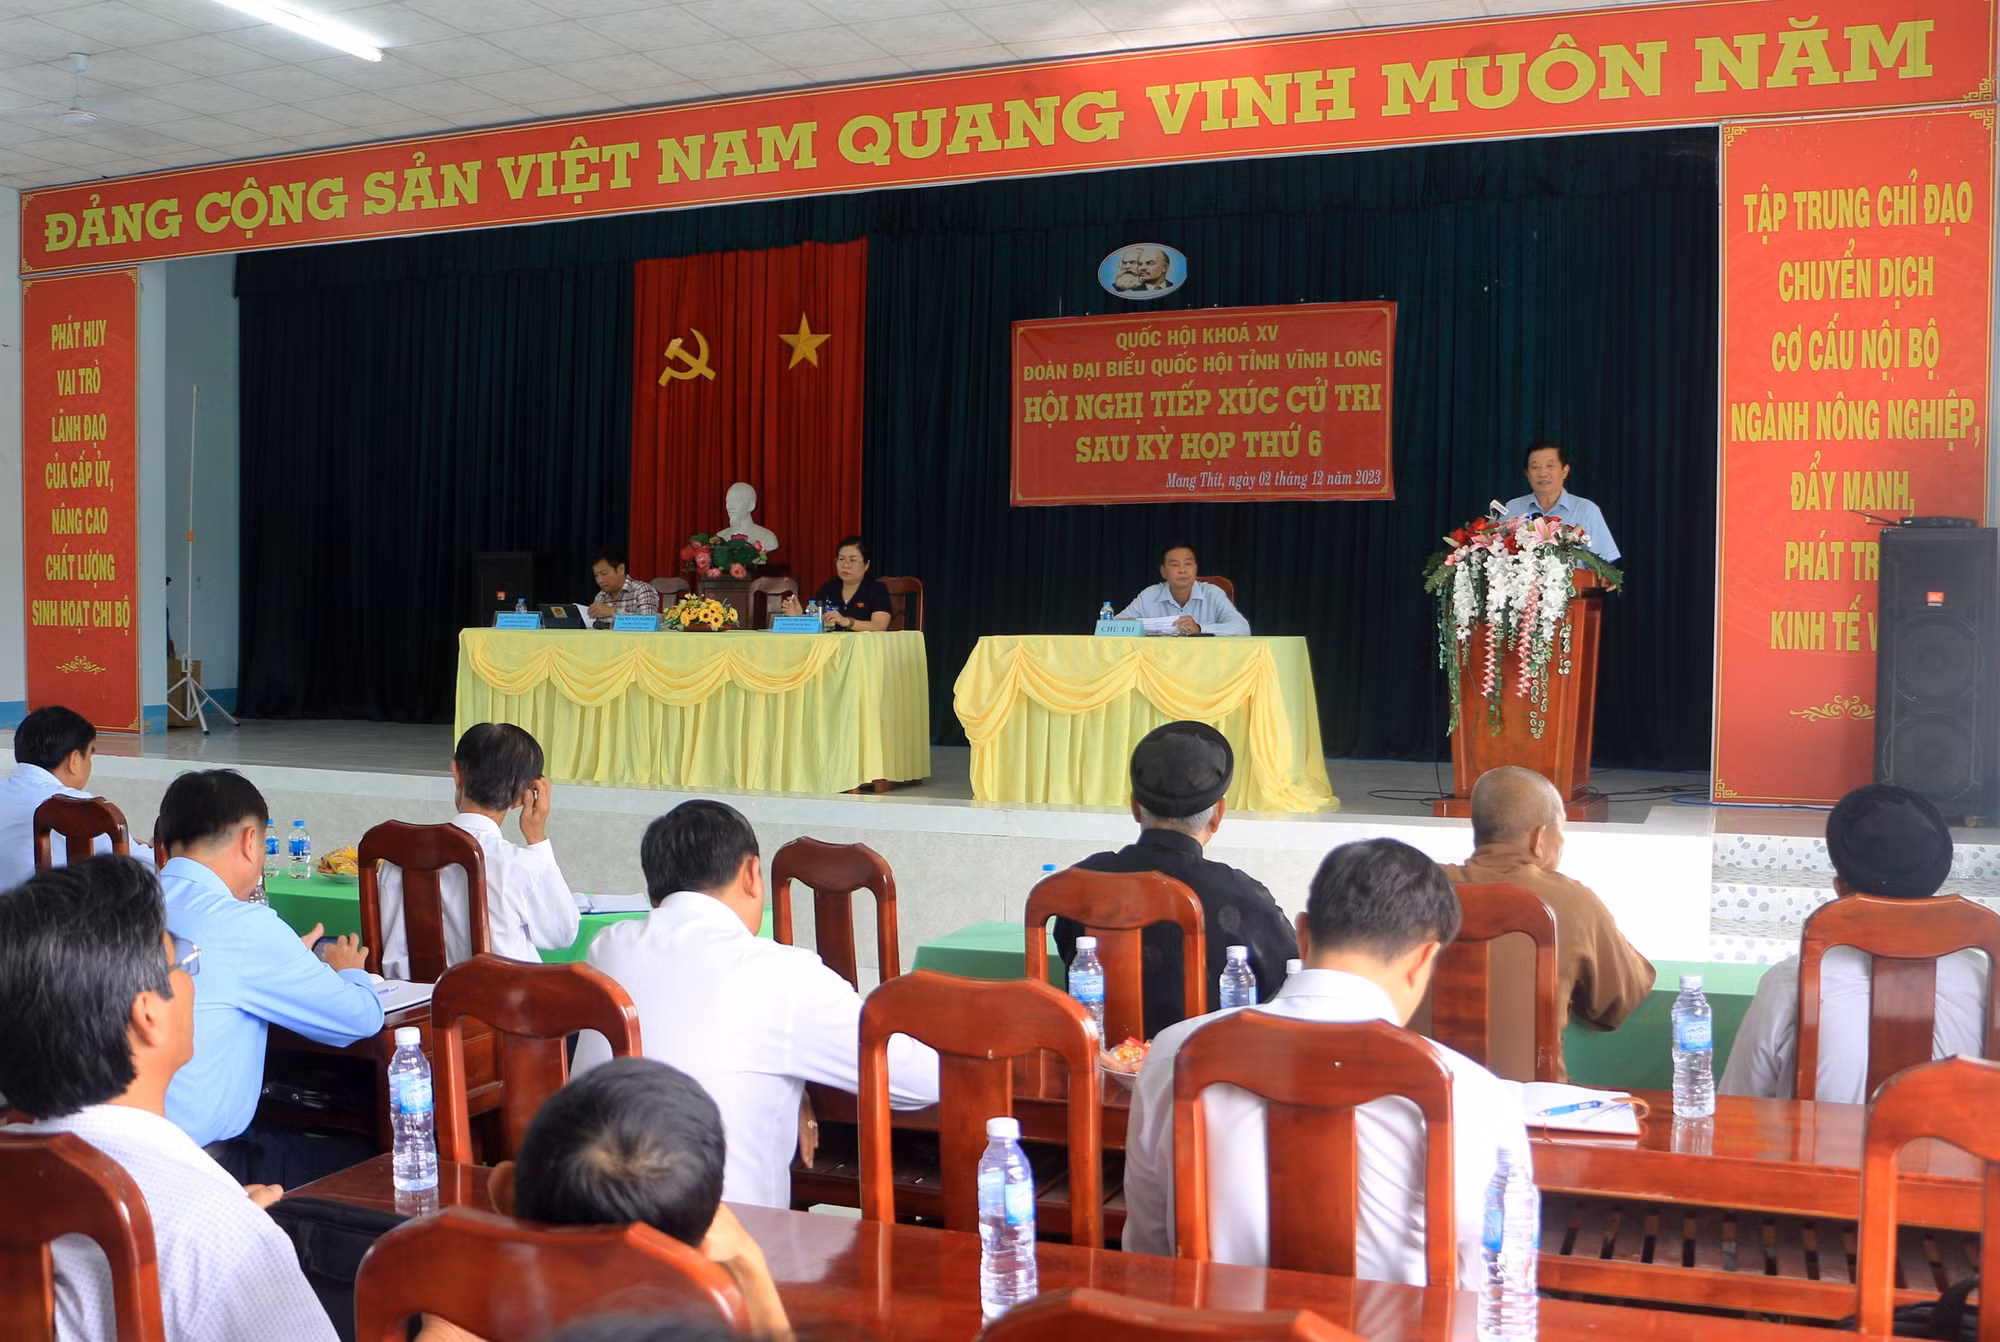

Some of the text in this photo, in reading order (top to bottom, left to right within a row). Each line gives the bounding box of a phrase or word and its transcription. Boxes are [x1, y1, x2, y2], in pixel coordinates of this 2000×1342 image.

[44, 15, 1935, 253] ĐẢNG CỘNG SẢN VIỆT NAM QUANG VINH MUÔN NĂM
[1743, 168, 1973, 245] TẬP TRUNG CHỈ ĐẠO
[1778, 237, 1935, 310] CHUYỂN DỊCH
[51, 315, 107, 351] PHÁT HUY
[1115, 321, 1279, 352] QUỐC HỘI KHOÁ XV
[1771, 312, 1940, 383] CƠ CẤU NỘI BỘ
[56, 359, 101, 397] VAI TRÒ
[1023, 348, 1383, 382] ĐOÀN ĐẠI BIỂU QUỐC HỘI TỈNH VĨNH LONG
[1023, 375, 1382, 429] HỘI NGHỊ TIẾP XÚC CỬ TRI
[1731, 388, 1981, 451] NGÀNH NÔNG NGHIỆP,
[51, 408, 107, 449] LÃNH ĐẠO
[1075, 421, 1323, 466] SAU KỲ HỌP THỨ 6
[45, 449, 114, 492] CỦA CẤP ỦY,
[1166, 469, 1381, 491] Mang Thít, ngày 02 tháng 12 năm 2023
[1790, 450, 1915, 523] ĐẨY MẠNH,
[51, 501, 109, 535] NÂNG CAO
[45, 542, 116, 589] CHẤT LƯỢNG
[1784, 529, 1845, 581] PHÁT
[31, 594, 131, 637] SINH HOẠT CHI BỘ
[1770, 610, 1826, 651] KINH
[1831, 593, 1862, 651] TẾ
